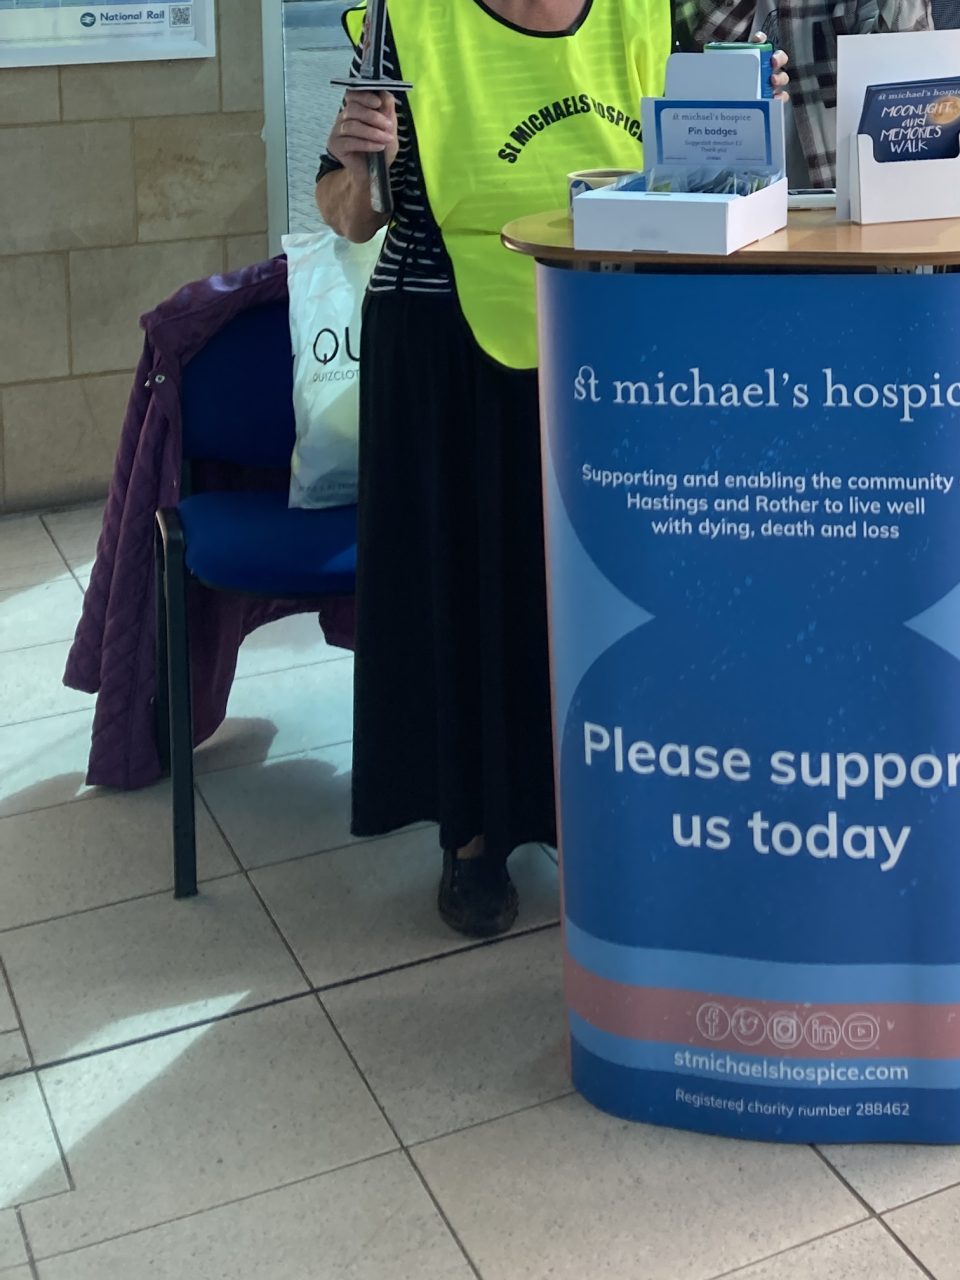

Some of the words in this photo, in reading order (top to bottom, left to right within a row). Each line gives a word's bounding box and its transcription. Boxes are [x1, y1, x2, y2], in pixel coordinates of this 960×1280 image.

[100, 11, 142, 21] National
[147, 10, 165, 20] Rail
[888, 89, 931, 100] michael's
[509, 94, 592, 147] MICHAELS
[591, 97, 643, 143] OSPIC
[681, 112, 719, 120] michael's
[720, 112, 752, 123] hospice
[881, 101, 955, 118] MOONLIGHT
[901, 115, 927, 127] and
[688, 126, 703, 135] Pin
[704, 126, 738, 137] badges
[880, 125, 942, 141] MEMORIES
[498, 142, 522, 164] St
[890, 139, 929, 153] WALK
[573, 365, 601, 402] st
[612, 367, 810, 408] michael's
[582, 463, 677, 491] Supporting
[683, 471, 719, 488] and
[725, 471, 806, 493] enabling
[811, 472, 842, 490] the
[847, 472, 954, 494] community
[627, 492, 708, 515] Hastings
[713, 495, 749, 512] and
[756, 495, 819, 514] Rother
[824, 497, 844, 514] to
[849, 496, 881, 514] live
[887, 497, 926, 515] well
[651, 518, 693, 535] with
[698, 518, 756, 541] dying,
[761, 519, 815, 537] death
[821, 520, 856, 538] and
[862, 520, 899, 539] loss
[583, 721, 751, 782] Please
[672, 813, 731, 850] us
[747, 810, 912, 872] today
[673, 1051, 909, 1086] stmichaelshospice.com
[675, 1087, 744, 1115] Registered
[747, 1102, 794, 1119] charity
[798, 1104, 851, 1117] number
[856, 1103, 910, 1117] 288462
